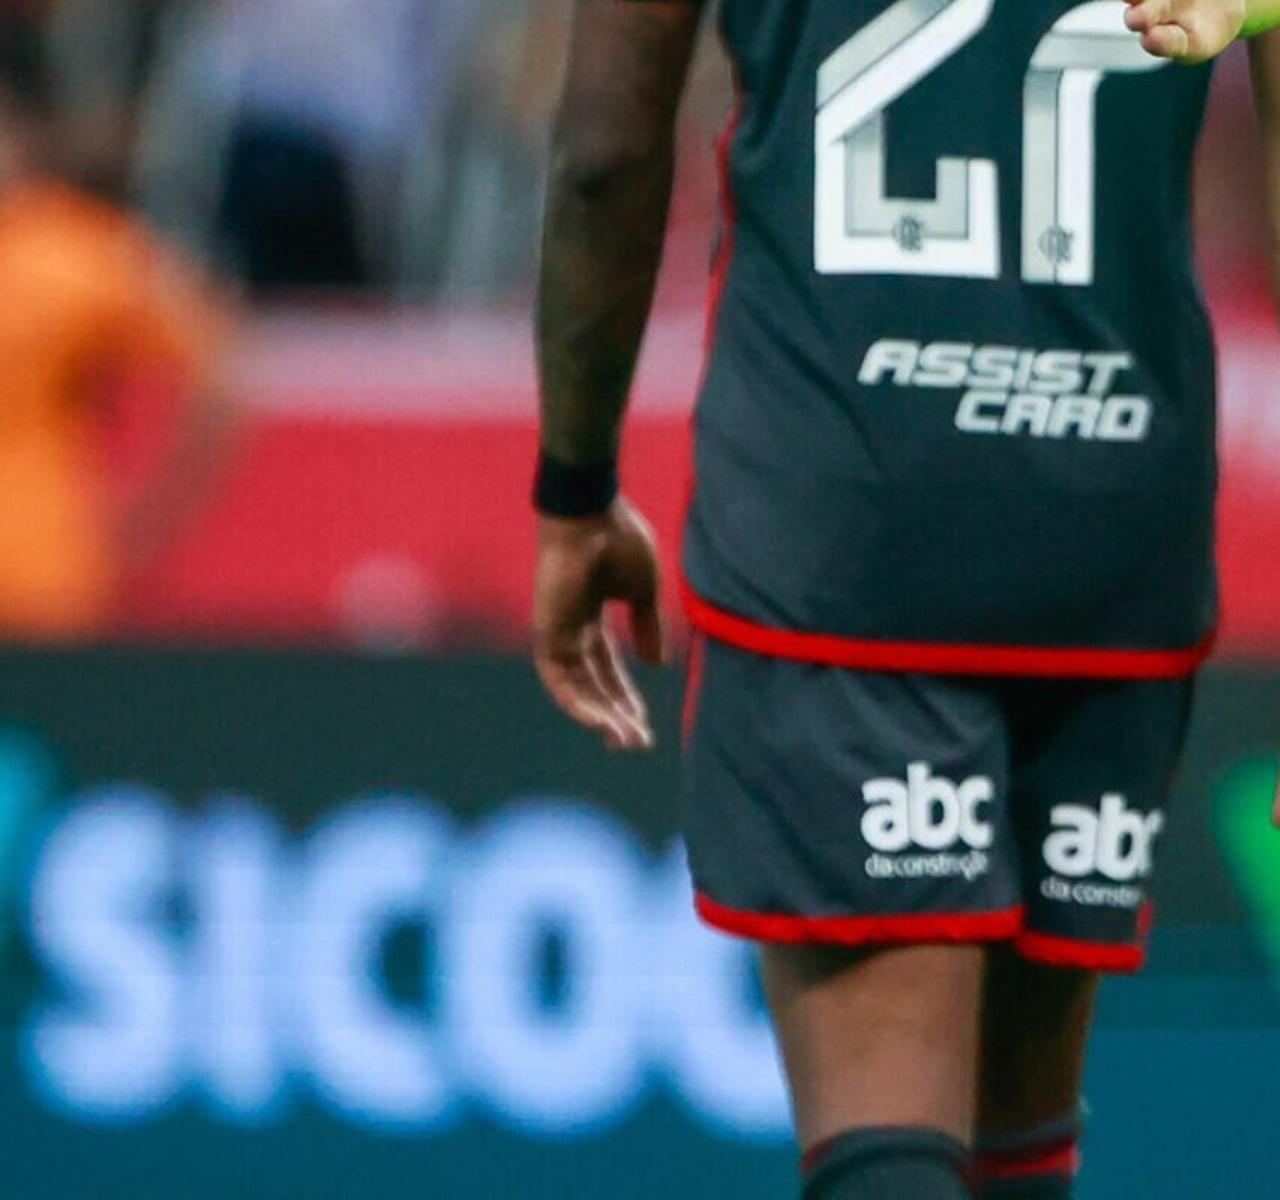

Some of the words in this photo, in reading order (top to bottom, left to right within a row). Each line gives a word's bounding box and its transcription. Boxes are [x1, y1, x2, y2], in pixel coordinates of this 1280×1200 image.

[858, 338, 1135, 394] ASSIST
[954, 393, 1153, 441] CARD
[860, 760, 995, 853] abc
